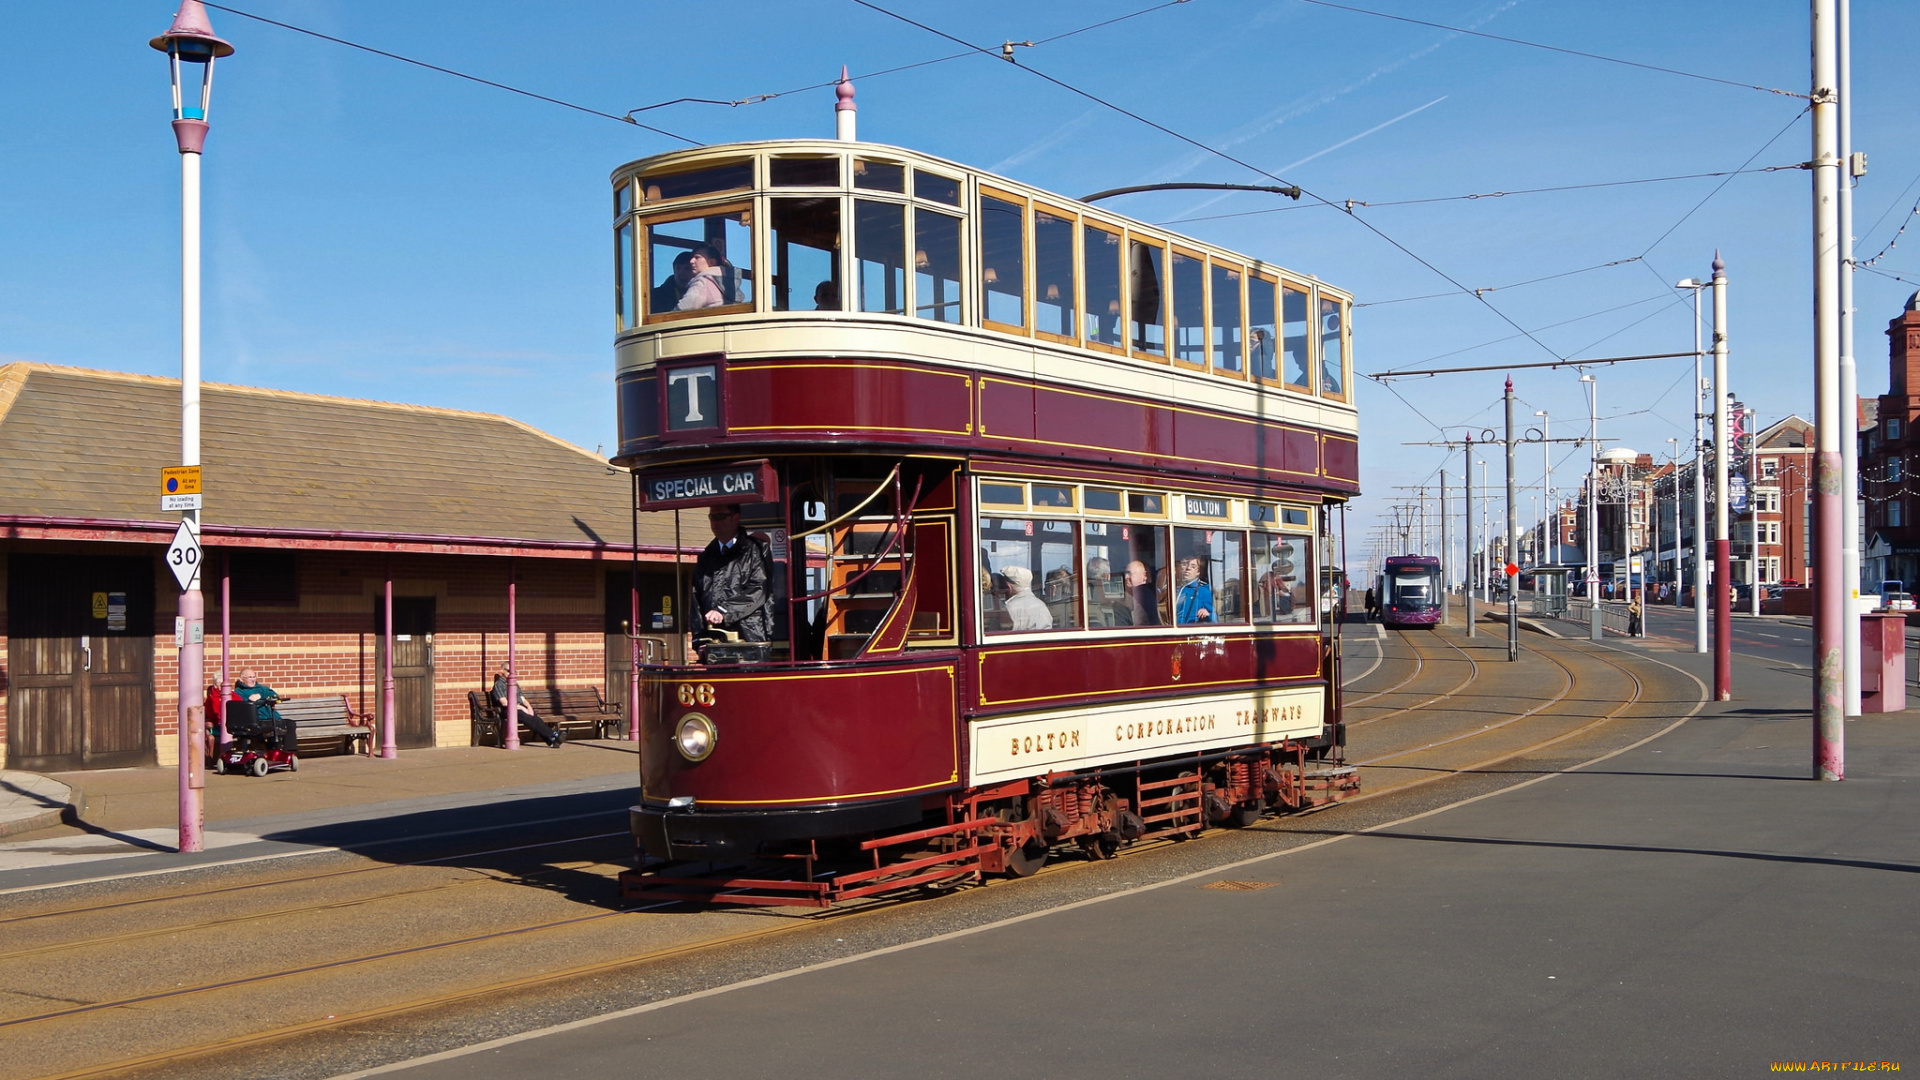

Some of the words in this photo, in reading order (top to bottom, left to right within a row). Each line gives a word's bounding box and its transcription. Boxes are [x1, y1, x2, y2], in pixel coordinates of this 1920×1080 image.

[668, 372, 715, 422] T
[655, 477, 718, 500] SPECIAL
[723, 472, 755, 493] CAR
[1187, 500, 1220, 515] BOLTON
[172, 547, 197, 565] 30
[678, 683, 716, 707] 66
[1011, 730, 1080, 755] BOLTON
[1115, 714, 1216, 741] CORPORATION
[1236, 705, 1303, 726] TRAMWAYS
